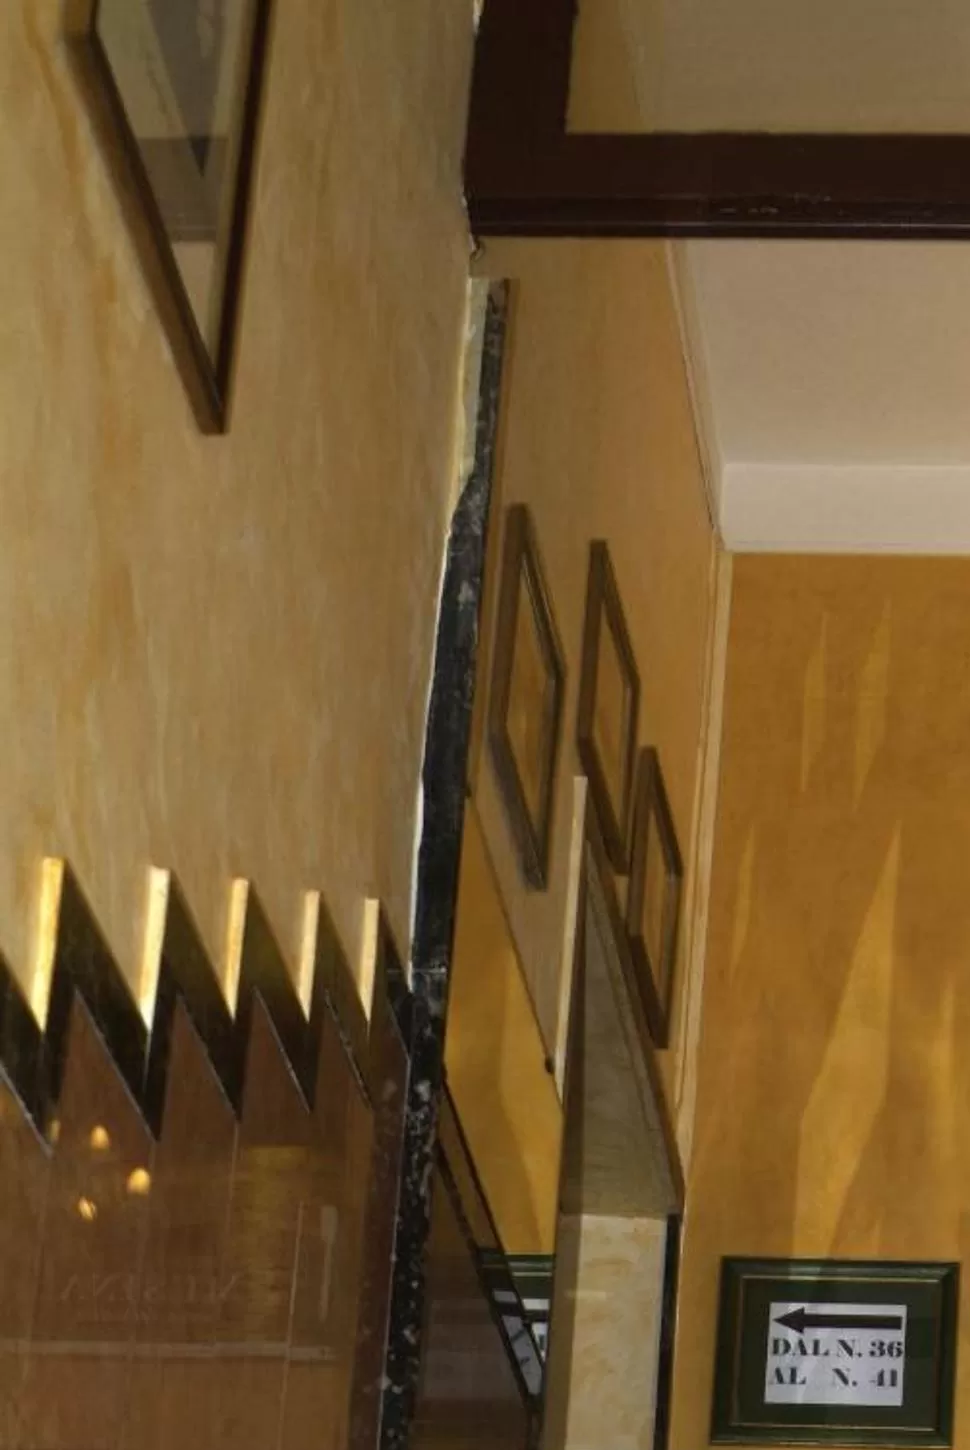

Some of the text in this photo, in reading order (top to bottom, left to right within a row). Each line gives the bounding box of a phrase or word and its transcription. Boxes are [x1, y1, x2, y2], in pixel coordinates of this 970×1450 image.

[771, 1338, 829, 1357] DAL
[869, 1340, 904, 1358] 36
[770, 1367, 899, 1387] AL N. 41
